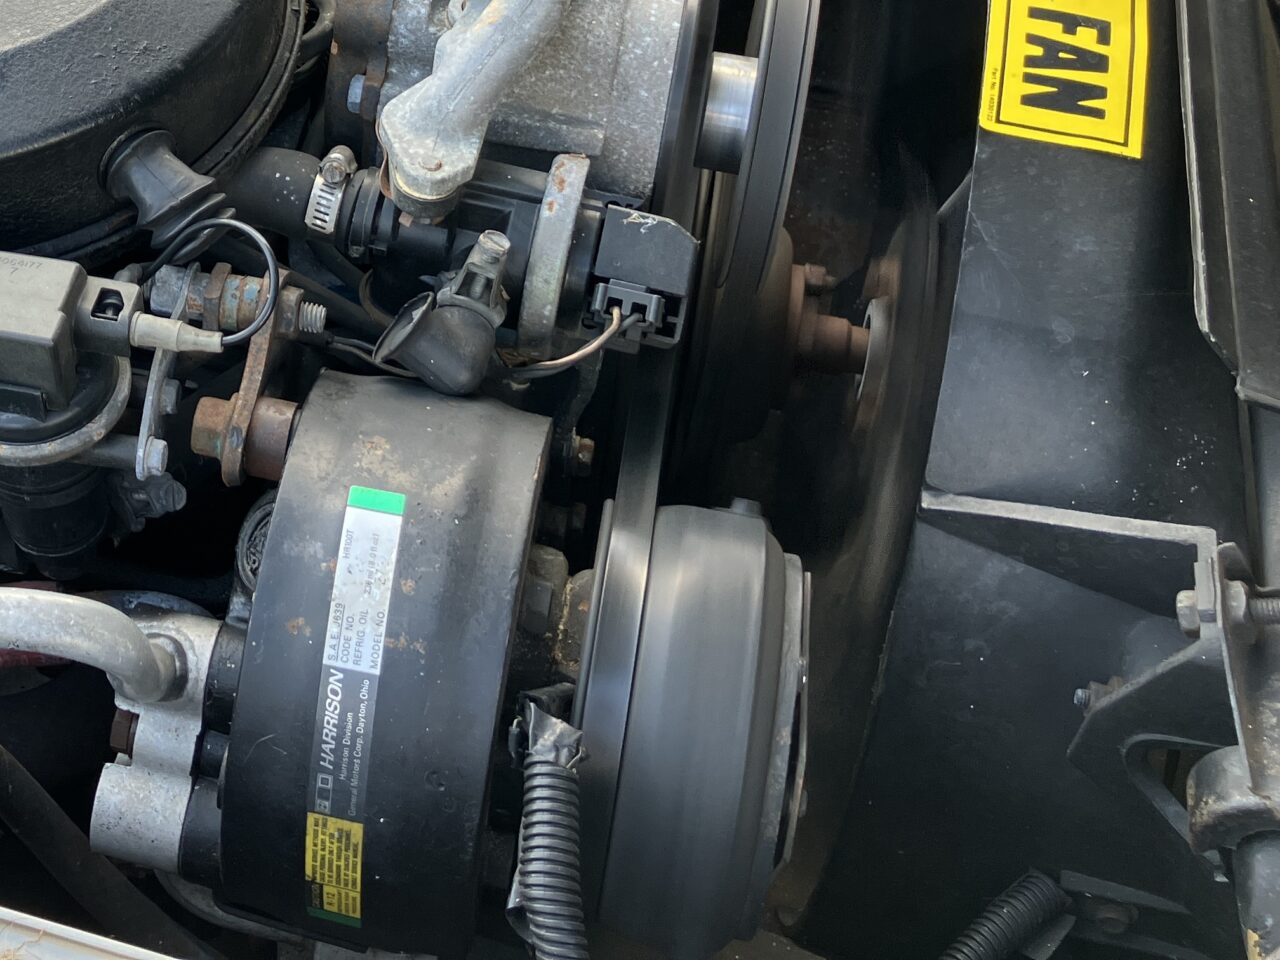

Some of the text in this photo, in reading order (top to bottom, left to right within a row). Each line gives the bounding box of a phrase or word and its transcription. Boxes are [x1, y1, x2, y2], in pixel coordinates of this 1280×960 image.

[1020, 6, 1112, 120] FAN
[332, 602, 345, 627] J639
[340, 613, 355, 664] CODE NO.
[353, 608, 369, 666] REFRIG. OIL
[370, 608, 386, 669] MODEL NO.
[359, 678, 370, 700] Ohio
[319, 668, 344, 770] HARRISON
[355, 700, 368, 735] Dayton,
[339, 711, 354, 781] Harrison Division
[353, 735, 365, 758] Corp.
[350, 758, 361, 787] Motors
[347, 788, 358, 817] General
